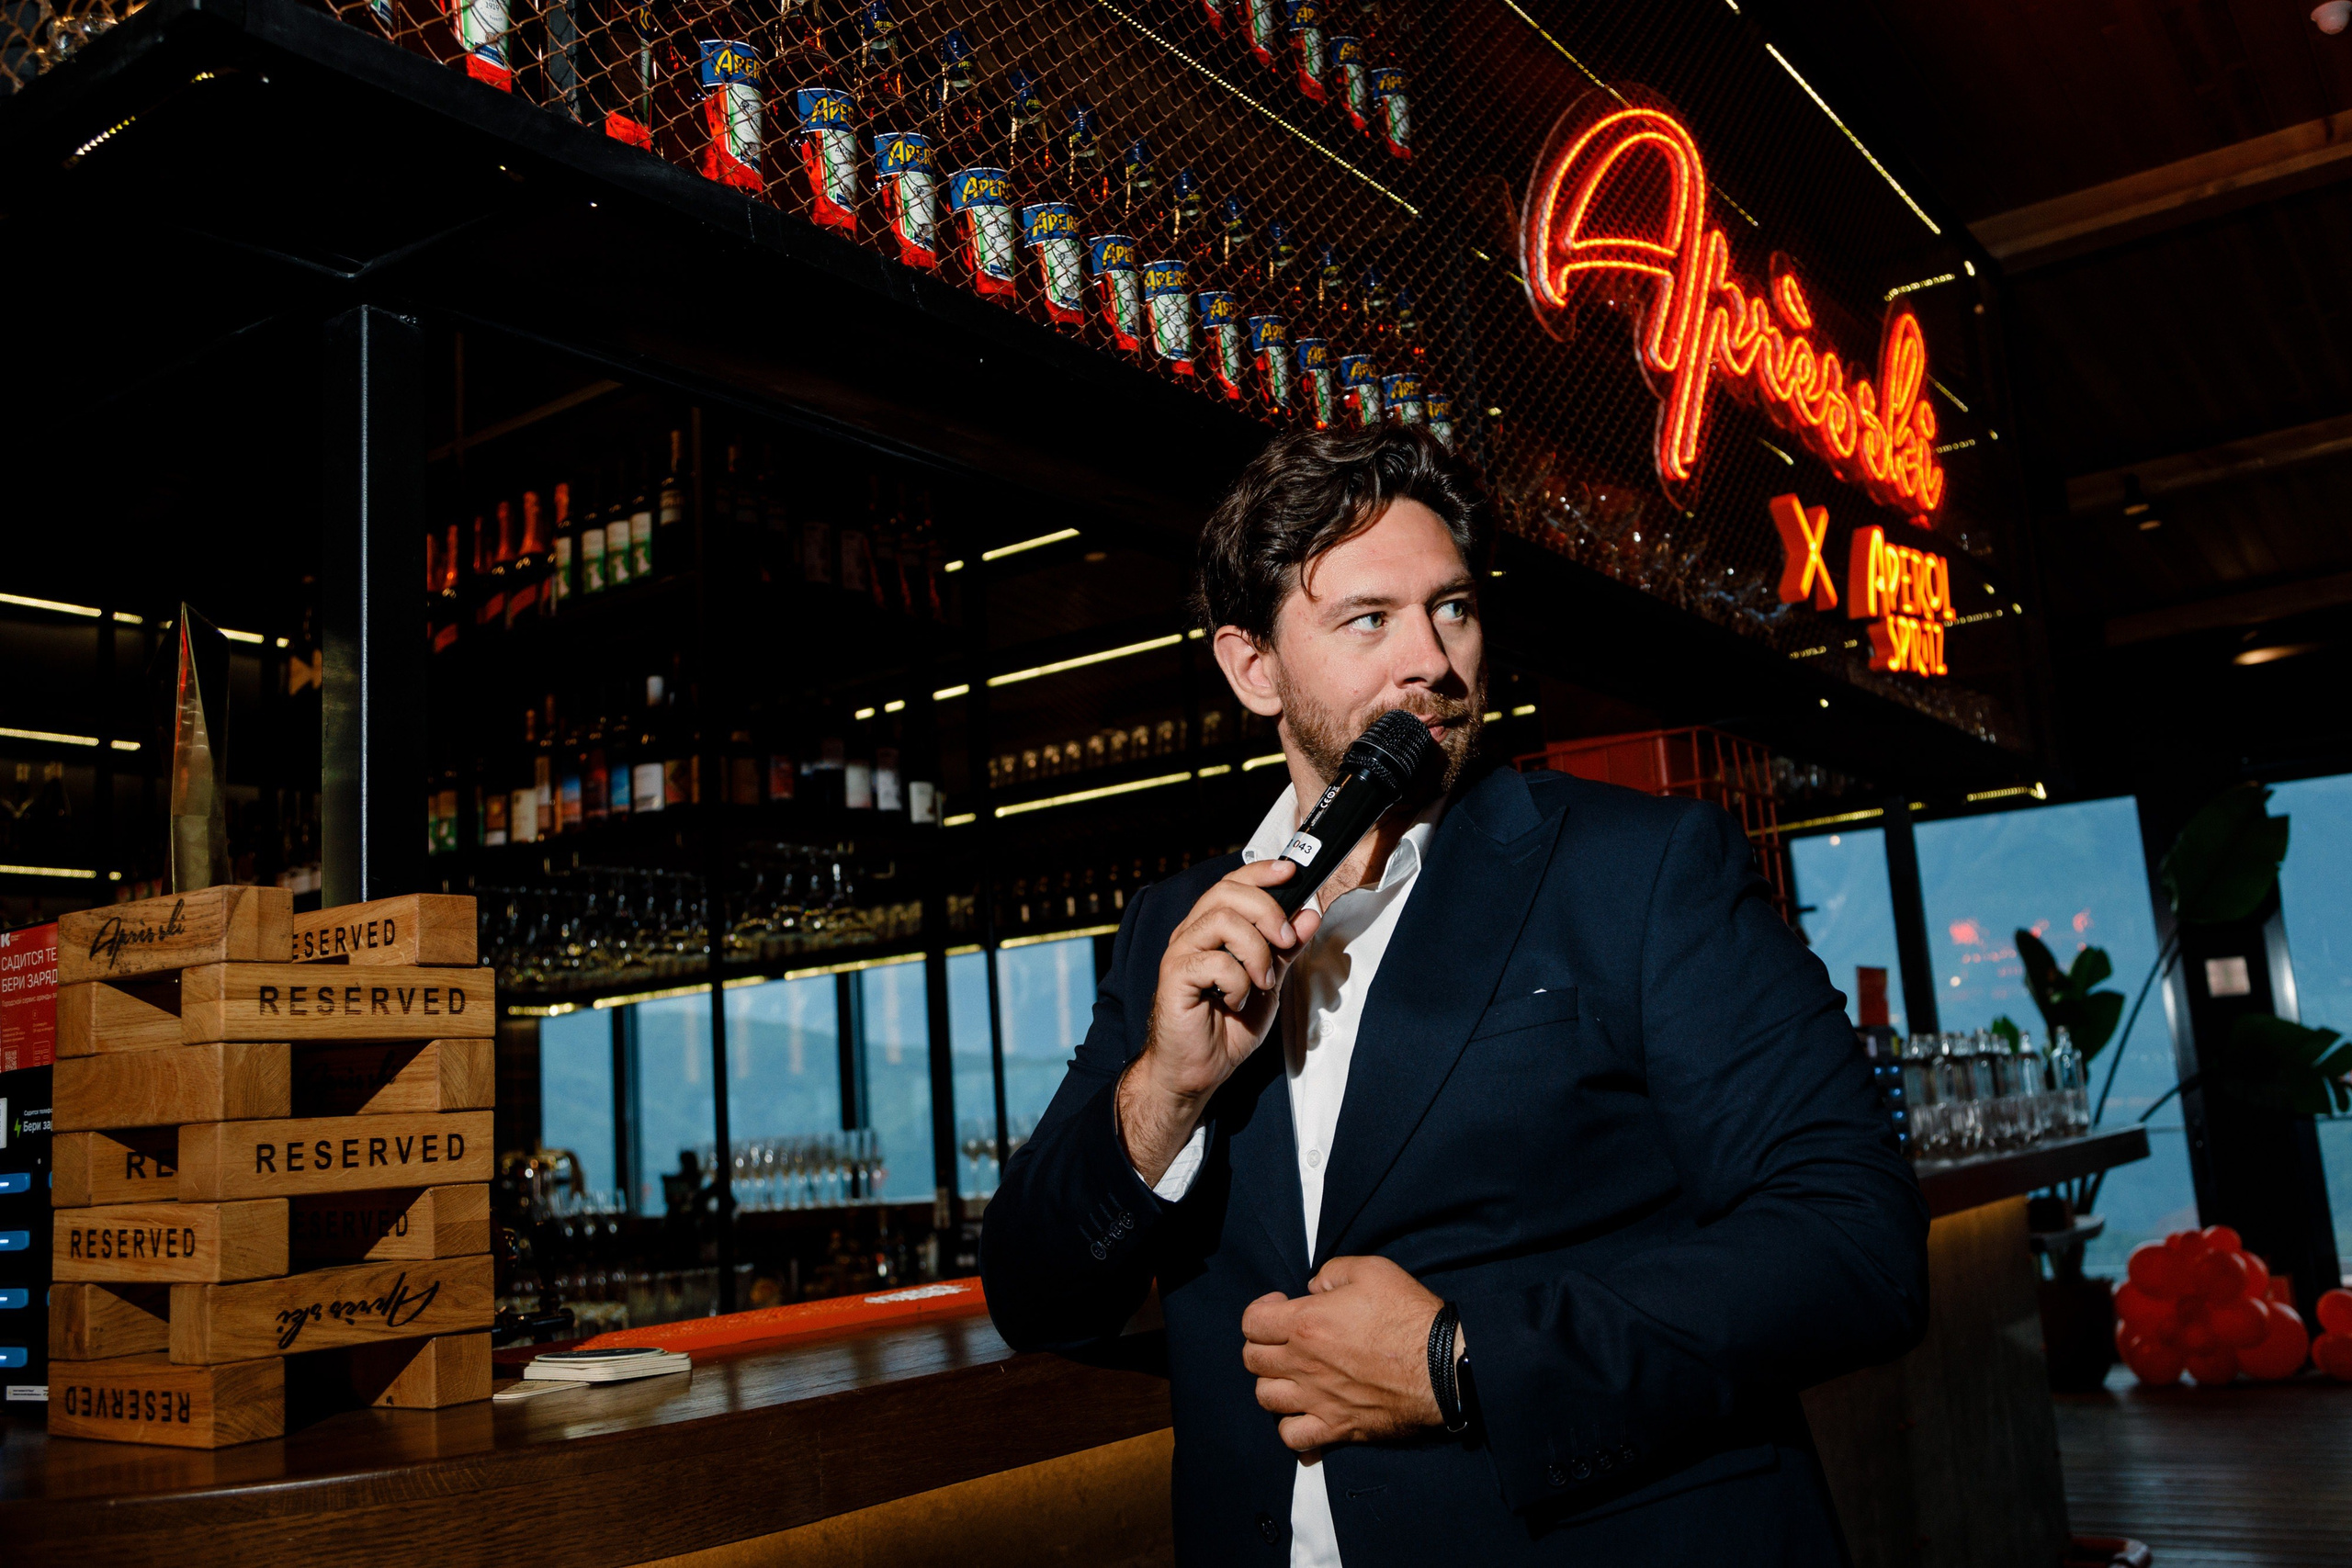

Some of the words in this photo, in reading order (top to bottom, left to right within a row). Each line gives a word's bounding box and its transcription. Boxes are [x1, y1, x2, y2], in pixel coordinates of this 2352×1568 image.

[1781, 493, 1837, 610] X
[1861, 525, 1957, 622] APEROL
[1, 949, 44, 971] САДИТСЯ
[46, 947, 57, 962] ТЕ
[2, 975, 26, 992] БЕРИ
[27, 968, 58, 988] ЗАРЯД
[259, 986, 466, 1015] RESERVED
[23, 1121, 41, 1134] Бери
[256, 1134, 465, 1173] RESERVED
[71, 1228, 196, 1258] RESERVED
[65, 1386, 190, 1423] RESERVED
